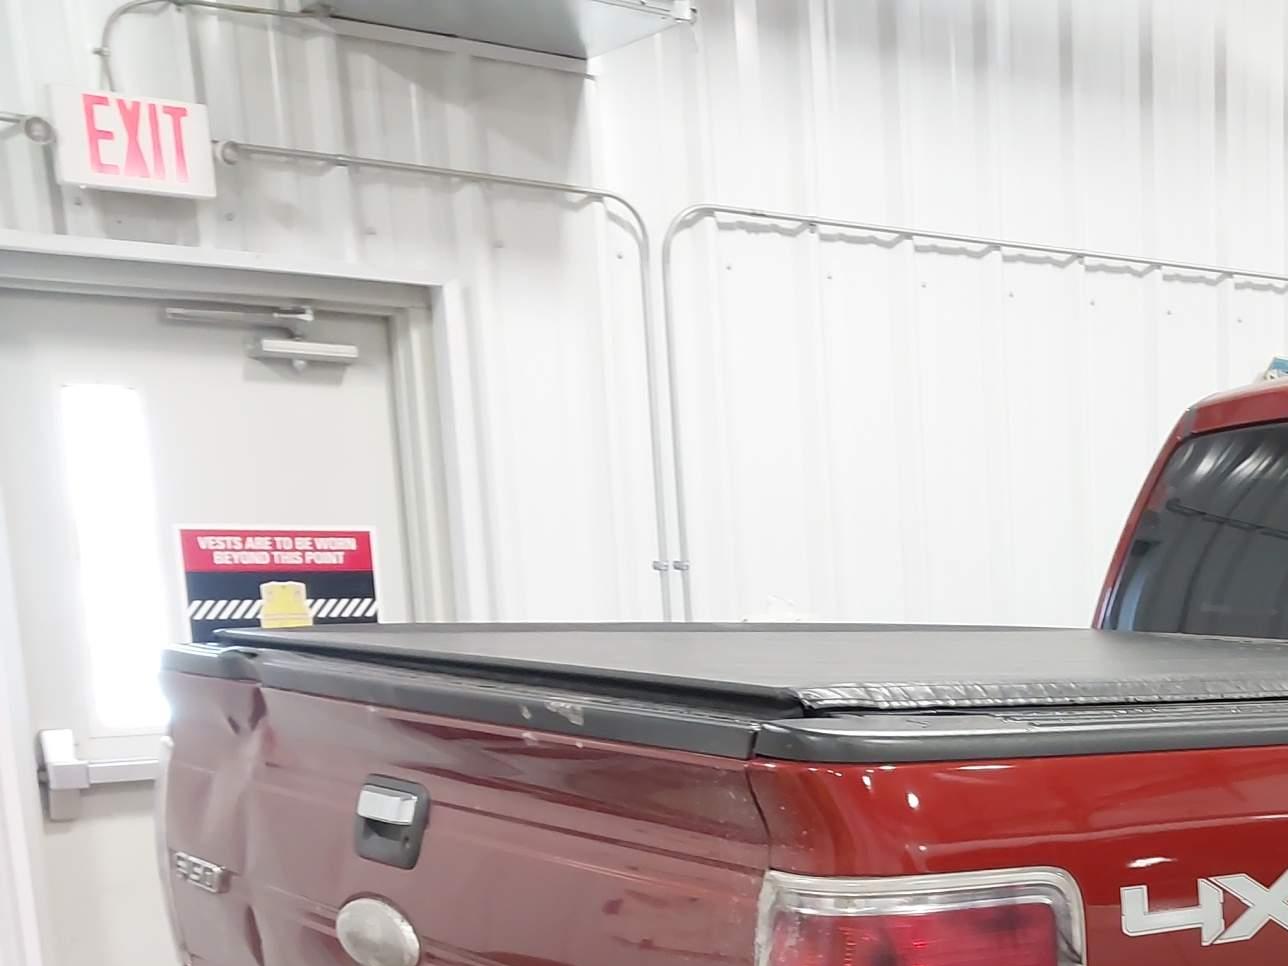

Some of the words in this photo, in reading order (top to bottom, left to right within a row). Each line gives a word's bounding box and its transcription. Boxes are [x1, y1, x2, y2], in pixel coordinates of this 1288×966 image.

[81, 93, 189, 184] EXIT
[197, 536, 242, 550] VESTS
[245, 536, 273, 550] ARE
[274, 537, 293, 550] TO
[294, 537, 312, 550] BE
[313, 537, 357, 550] WORN
[213, 551, 271, 565] BEYOND
[271, 551, 303, 565] THIS
[305, 551, 345, 565] POINT
